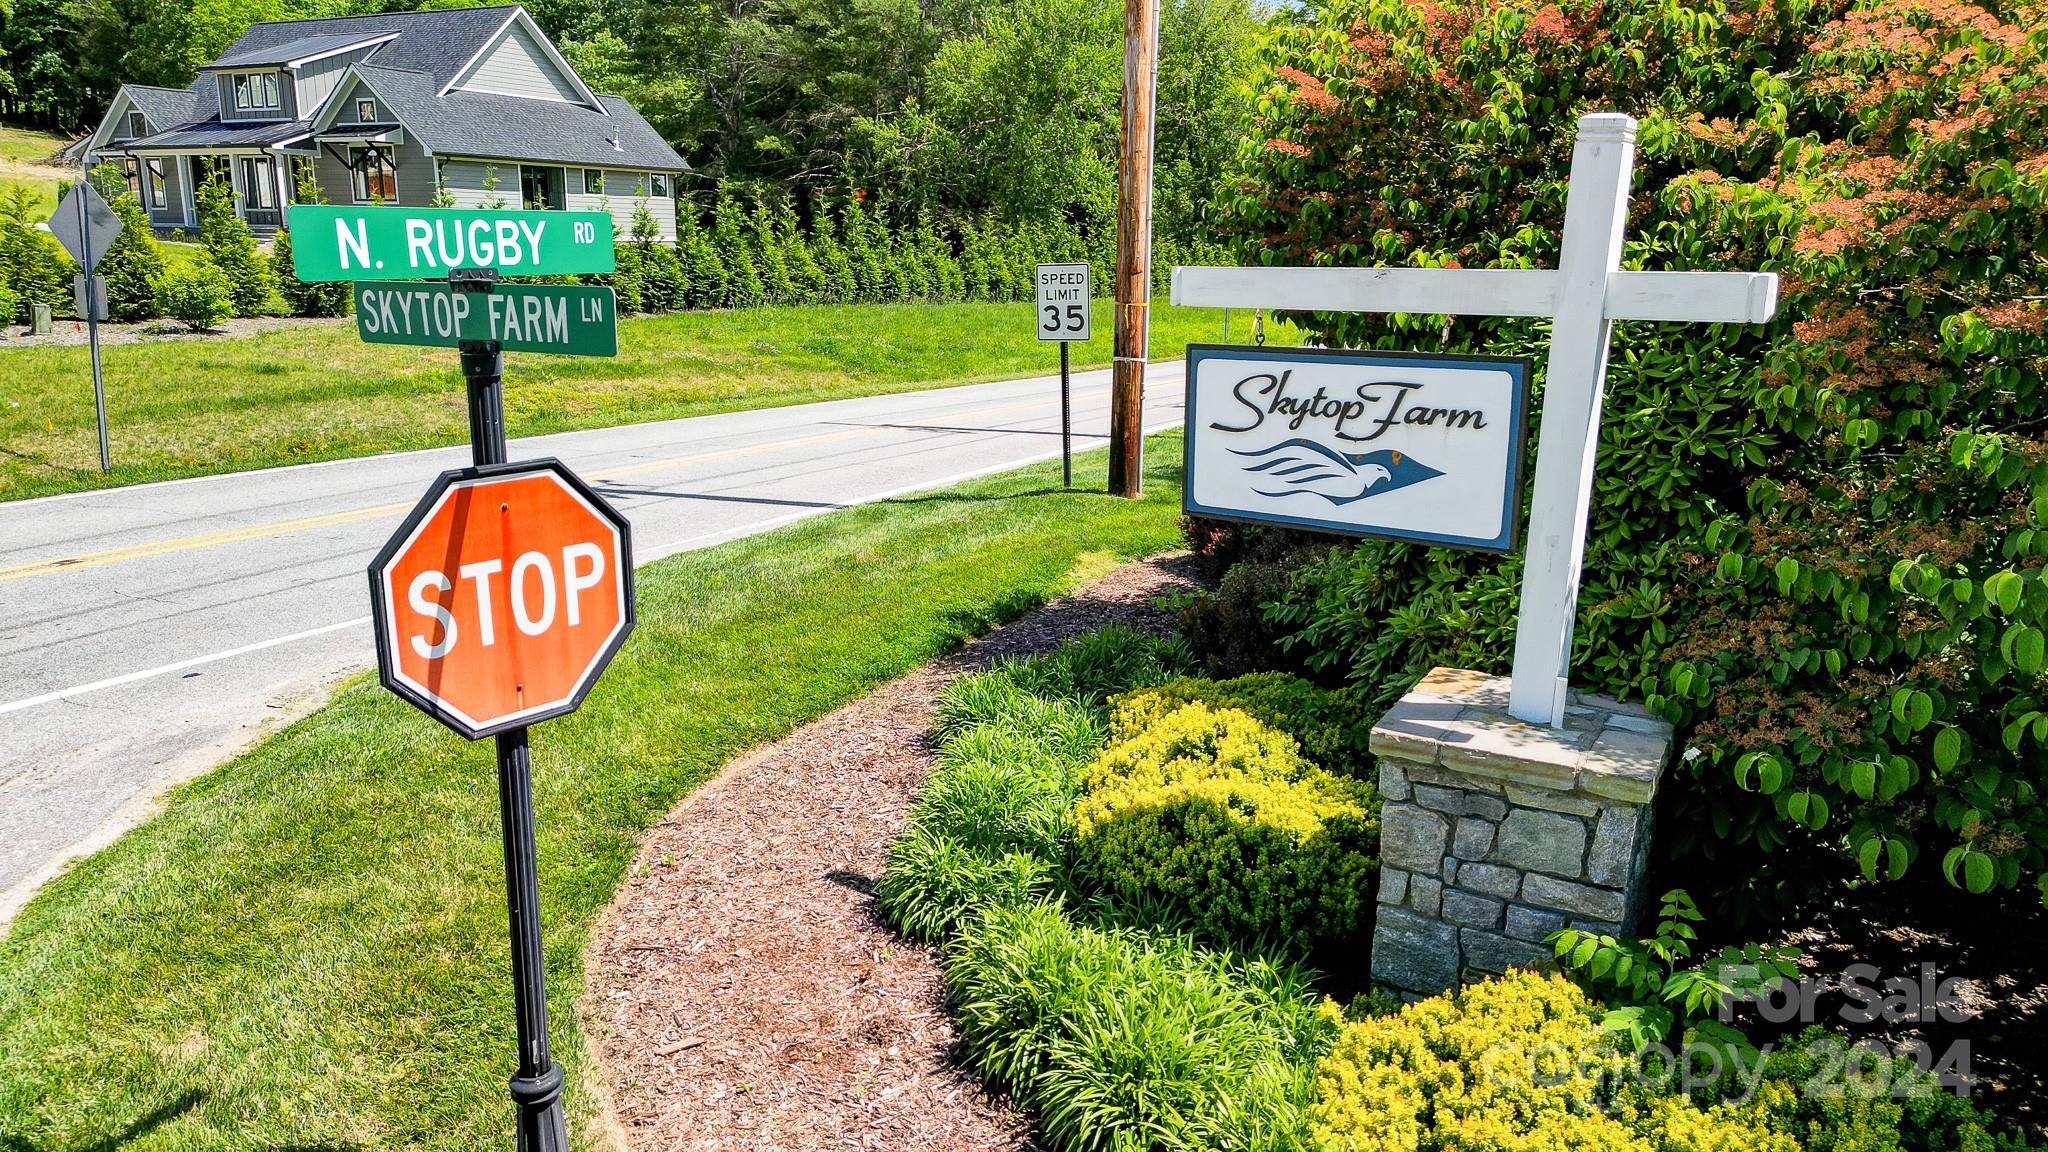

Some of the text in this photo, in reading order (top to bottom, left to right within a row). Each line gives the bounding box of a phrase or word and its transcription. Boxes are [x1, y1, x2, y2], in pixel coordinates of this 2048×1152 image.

[334, 217, 595, 270] N. RUGBY RD
[1040, 273, 1085, 285] SPEED
[1045, 289, 1080, 301] LIMIT
[361, 288, 603, 344] SKYTOP FARM LN
[1042, 304, 1086, 332] 35
[1208, 369, 1489, 442] Skytop Farm
[407, 541, 606, 660] STOP
